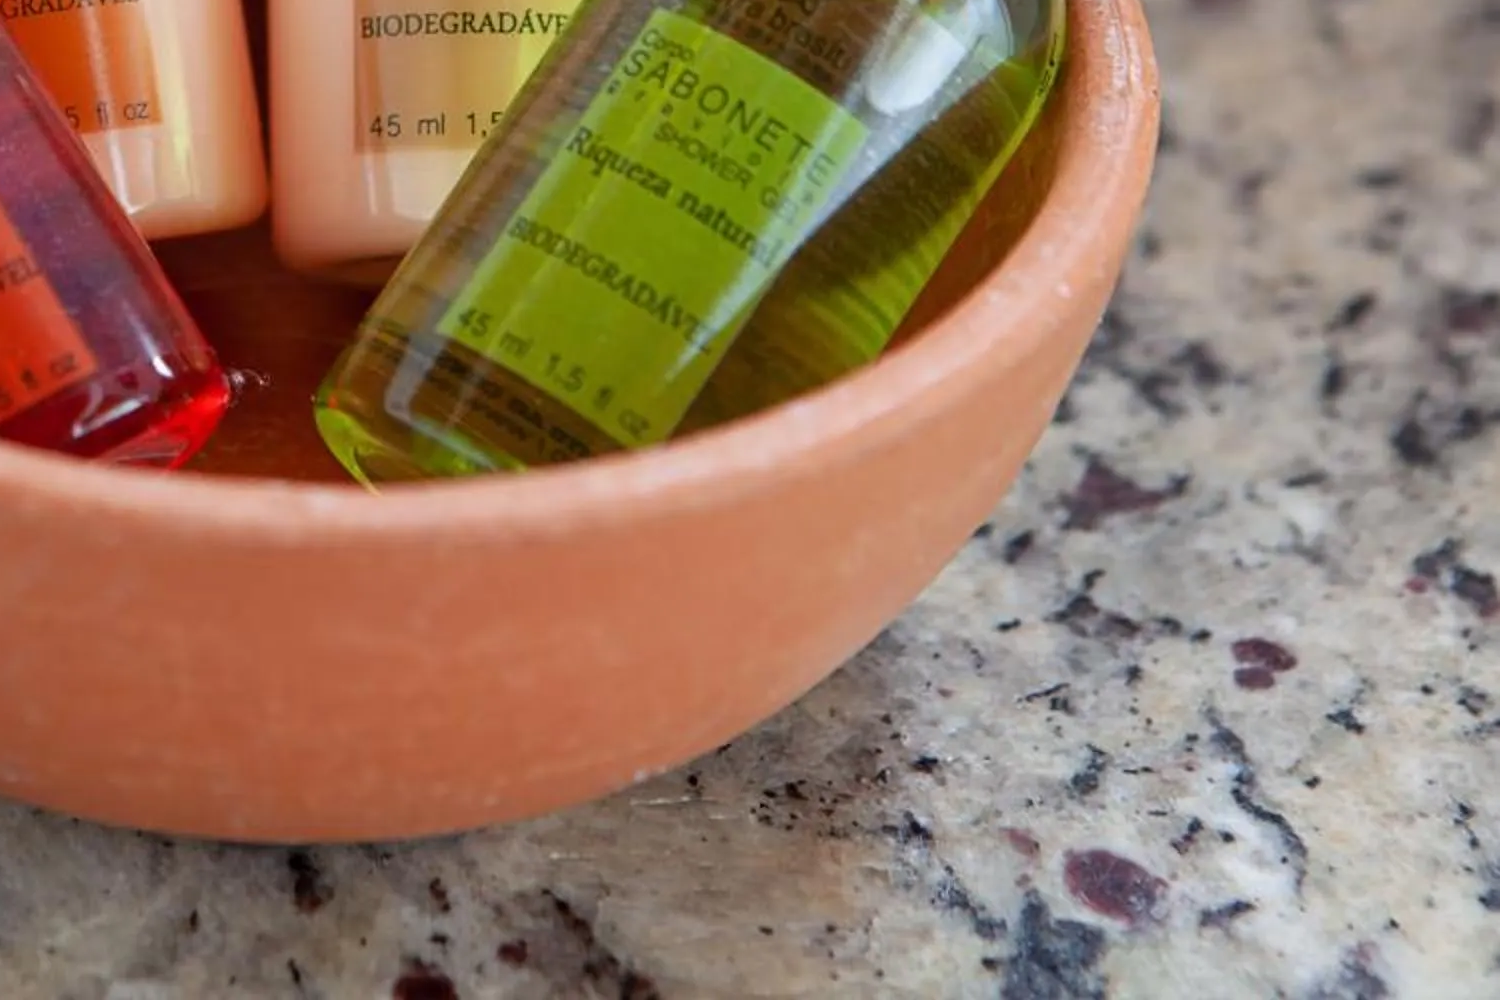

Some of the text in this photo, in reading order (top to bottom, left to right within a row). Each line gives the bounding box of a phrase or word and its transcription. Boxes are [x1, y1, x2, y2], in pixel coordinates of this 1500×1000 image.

[360, 8, 570, 39] BIODEGRADÁVE
[122, 101, 150, 121] oz
[369, 114, 402, 138] 45
[417, 112, 446, 136] ml
[622, 50, 837, 188] SABONETE
[653, 121, 755, 190] SHOWER
[567, 125, 784, 269] Riqueza natural
[457, 306, 494, 338] 45
